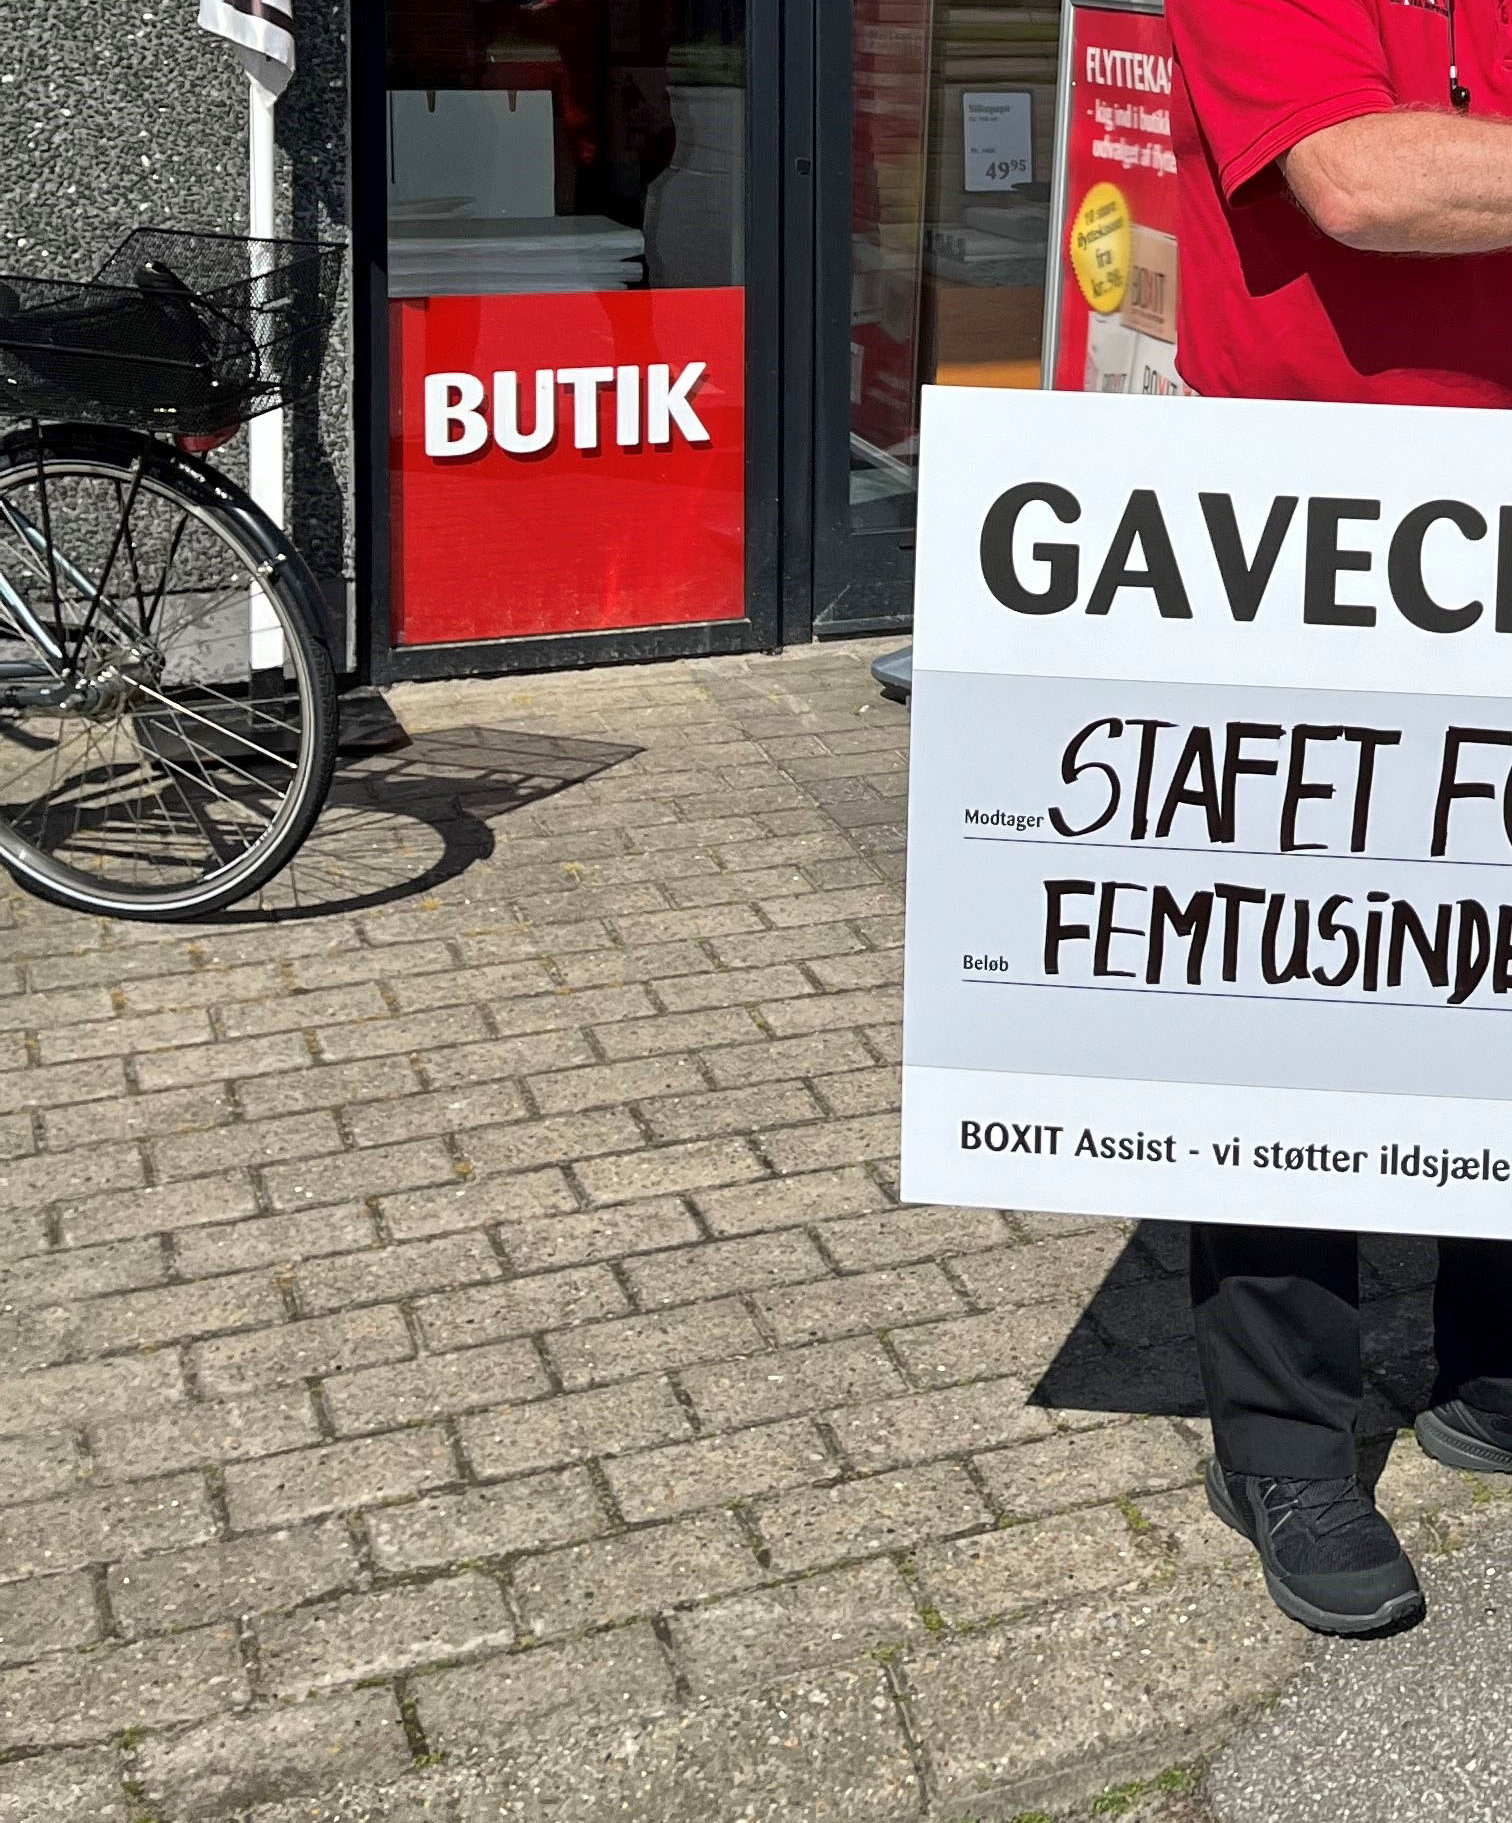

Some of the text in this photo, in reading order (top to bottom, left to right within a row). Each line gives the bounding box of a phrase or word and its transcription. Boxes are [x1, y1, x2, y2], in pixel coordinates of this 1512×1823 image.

[425, 361, 711, 457] BUTIK
[1048, 716, 1401, 852] STAFET
[964, 808, 1044, 832] Modtager
[963, 954, 1009, 973] Beløb
[960, 1120, 1063, 1157] BOXIT
[1075, 1126, 1176, 1163] Assist
[1212, 1136, 1240, 1166] vi
[1253, 1140, 1368, 1175] støtter
[1379, 1143, 1510, 1187] ildsjæle
